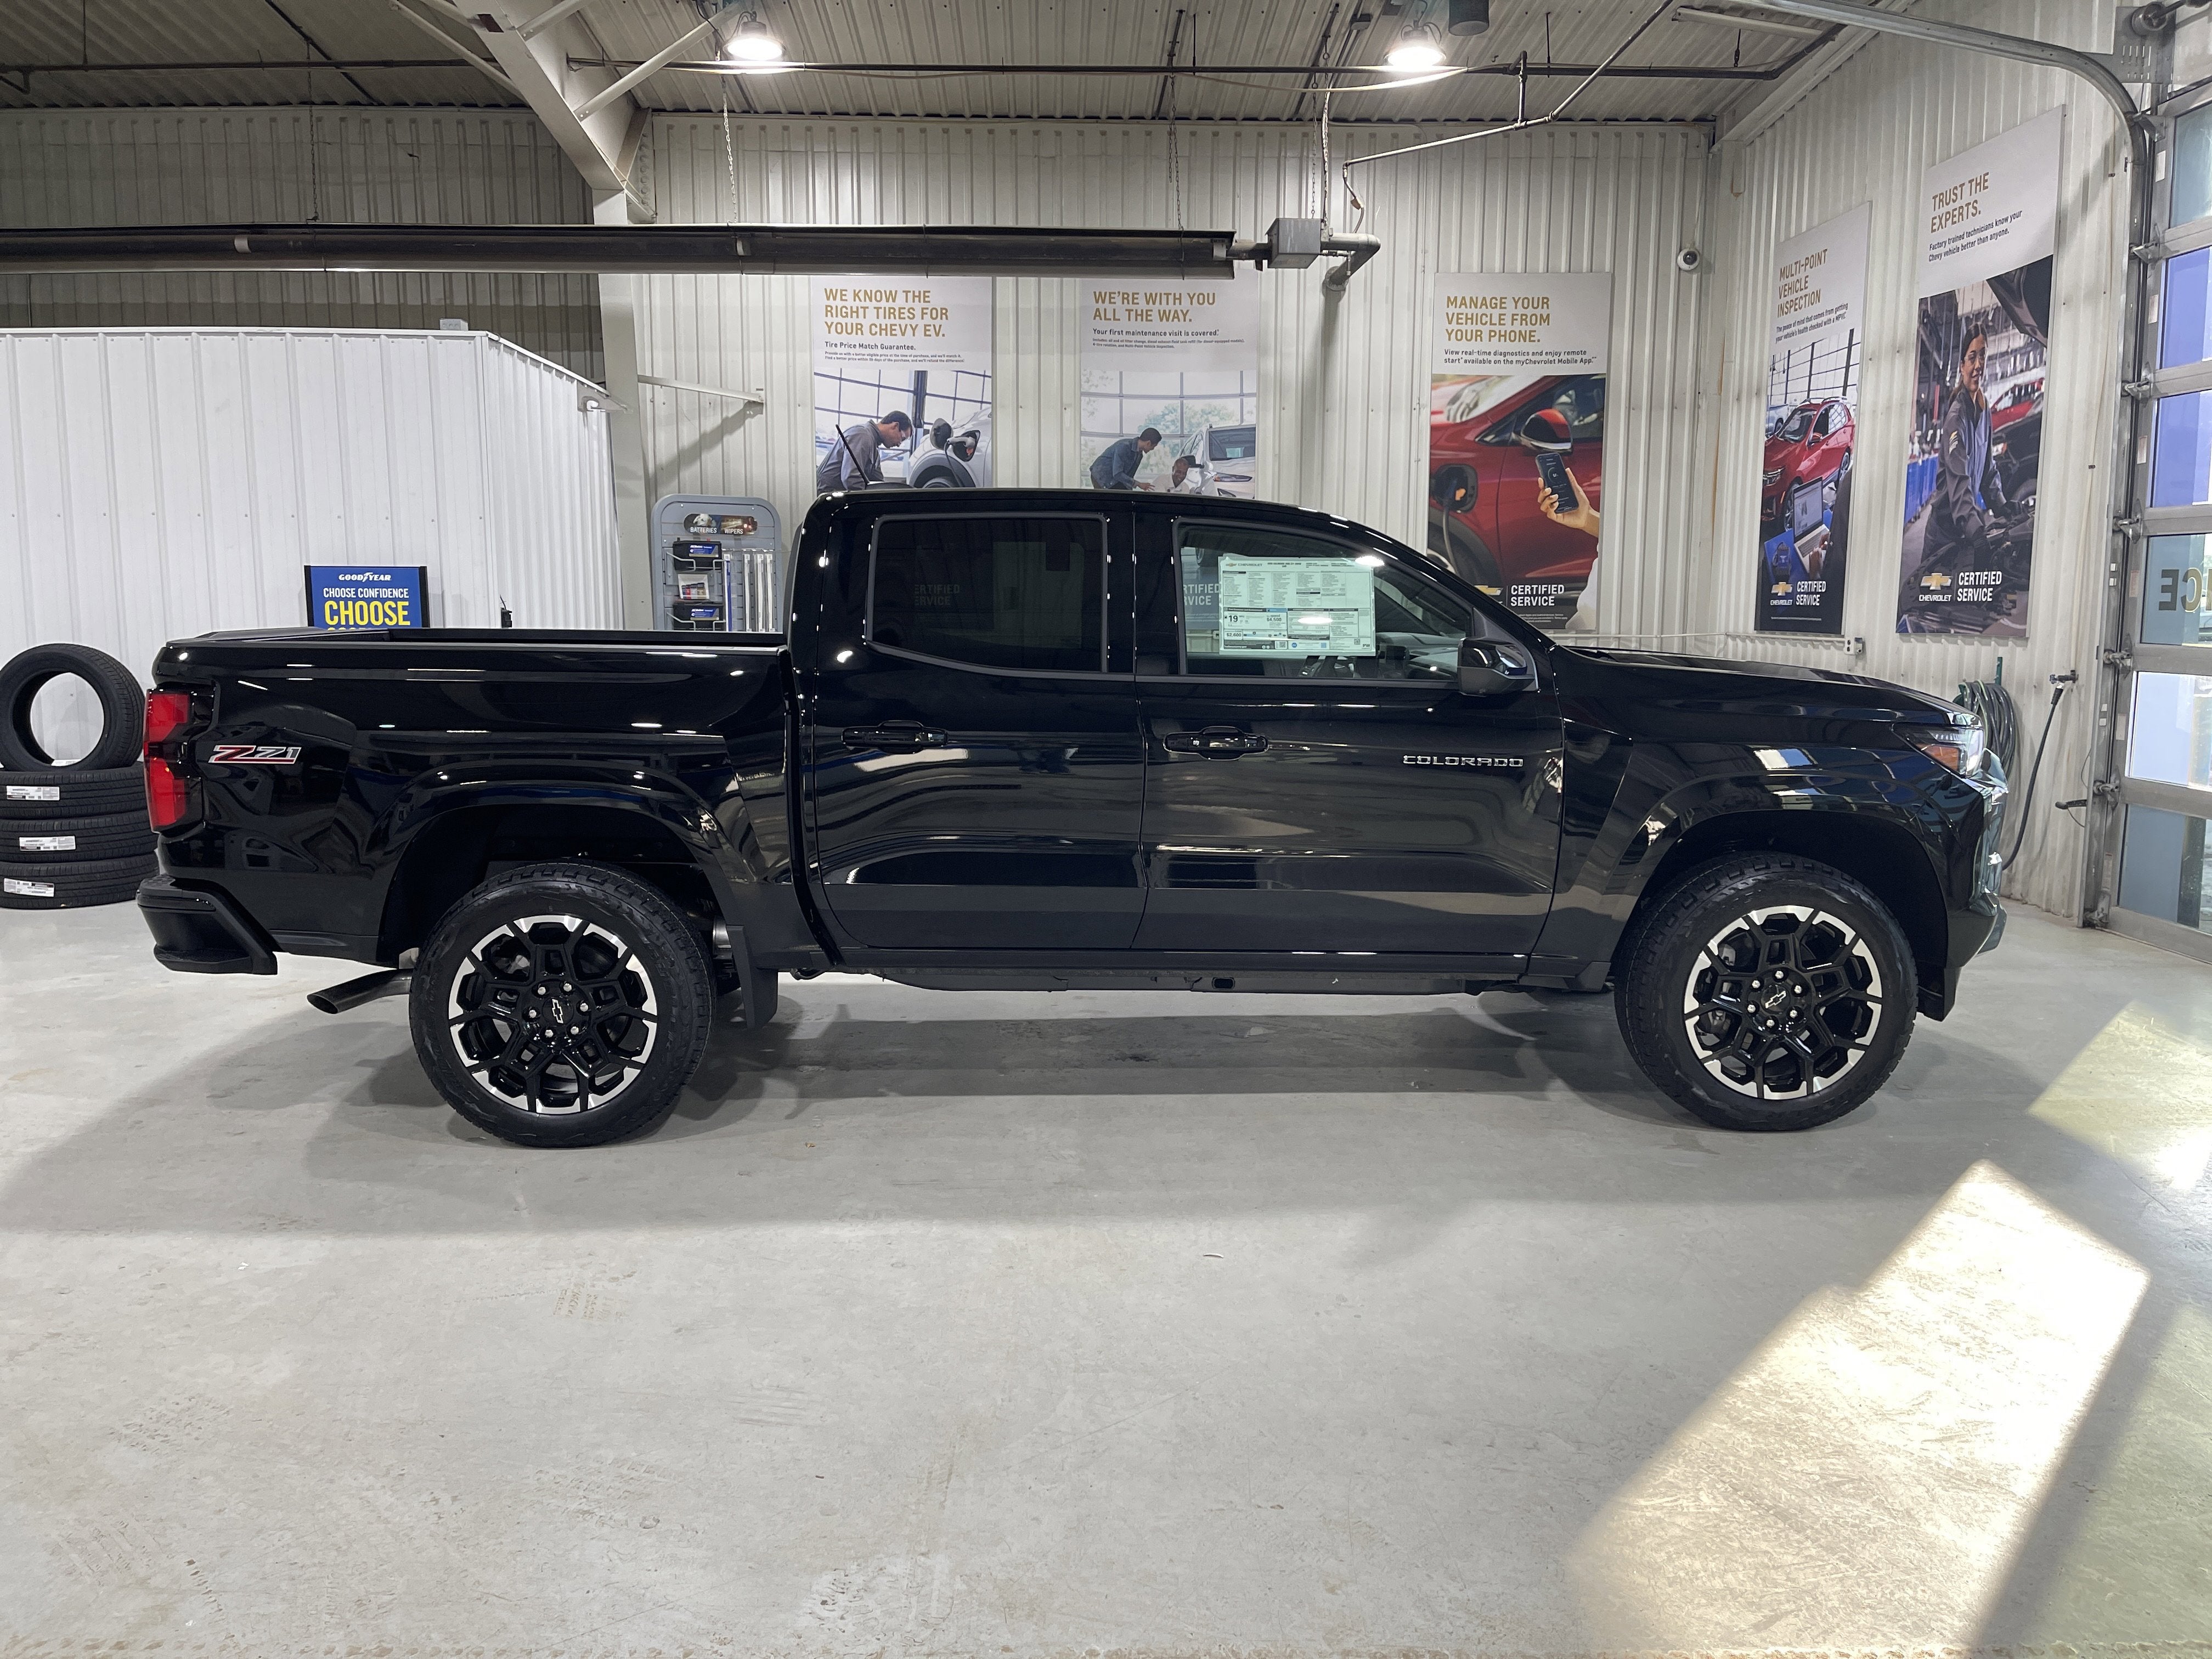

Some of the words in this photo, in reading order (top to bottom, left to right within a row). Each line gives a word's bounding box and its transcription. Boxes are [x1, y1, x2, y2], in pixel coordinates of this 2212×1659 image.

[1932, 182, 1965, 211] TRUST
[1968, 172, 1989, 196] THE
[1931, 200, 1981, 233] EXPERTS.
[1929, 239, 1947, 251] Factory
[1948, 232, 1965, 245] trained
[1966, 221, 1994, 238] technicians
[1995, 215, 2009, 227] know
[2010, 211, 2022, 223] your
[1929, 252, 1943, 262] Chevy
[1943, 246, 1960, 257] vehicle
[1961, 240, 1976, 251] better
[1977, 236, 1988, 245] than
[1989, 228, 2009, 240] anyone.
[1780, 249, 1828, 281] MULTI-POINT
[1779, 275, 1809, 300] VEHICLE
[824, 288, 848, 302] WE
[854, 289, 898, 303] KNOW
[902, 290, 931, 303] THE
[1093, 291, 1139, 305] WE'RE
[1144, 292, 1182, 306] WITH
[1187, 292, 1216, 306] YOU
[1447, 296, 1508, 309] MANAGE
[1512, 296, 1550, 309] YOUR
[1778, 289, 1821, 318] INSPECTION
[825, 304, 869, 319] RIGHT
[873, 306, 916, 320] TIRES
[921, 307, 949, 320] FOR
[1093, 308, 1120, 321] ALL
[1125, 309, 1153, 323] THE
[1158, 309, 1192, 323] WAY.
[1446, 312, 1506, 326] VEHICLE
[1511, 313, 1550, 326] FROM
[824, 321, 864, 336] YOUR
[869, 323, 918, 337] CHEVY
[924, 324, 946, 337] EV.
[1445, 329, 1483, 342] YOUR
[1488, 330, 1541, 342] PHONE.
[338, 572, 392, 583] GOODYEAR
[1959, 571, 2002, 586] CERTIFIED
[323, 588, 356, 598] CHOOSE
[358, 588, 409, 598] CONFIDENCE
[1183, 584, 1221, 594] RTIFIED
[1511, 584, 1565, 595] CERTIFIED
[1797, 581, 1826, 592] CERTIFIED
[1510, 596, 1555, 606] SERVICE
[1796, 595, 1820, 606] SERVICE
[1957, 588, 1994, 602] SERVICE
[324, 600, 411, 626] CHOOSE
[208, 745, 302, 764] Z71
[1403, 755, 1523, 767] COLORADO
